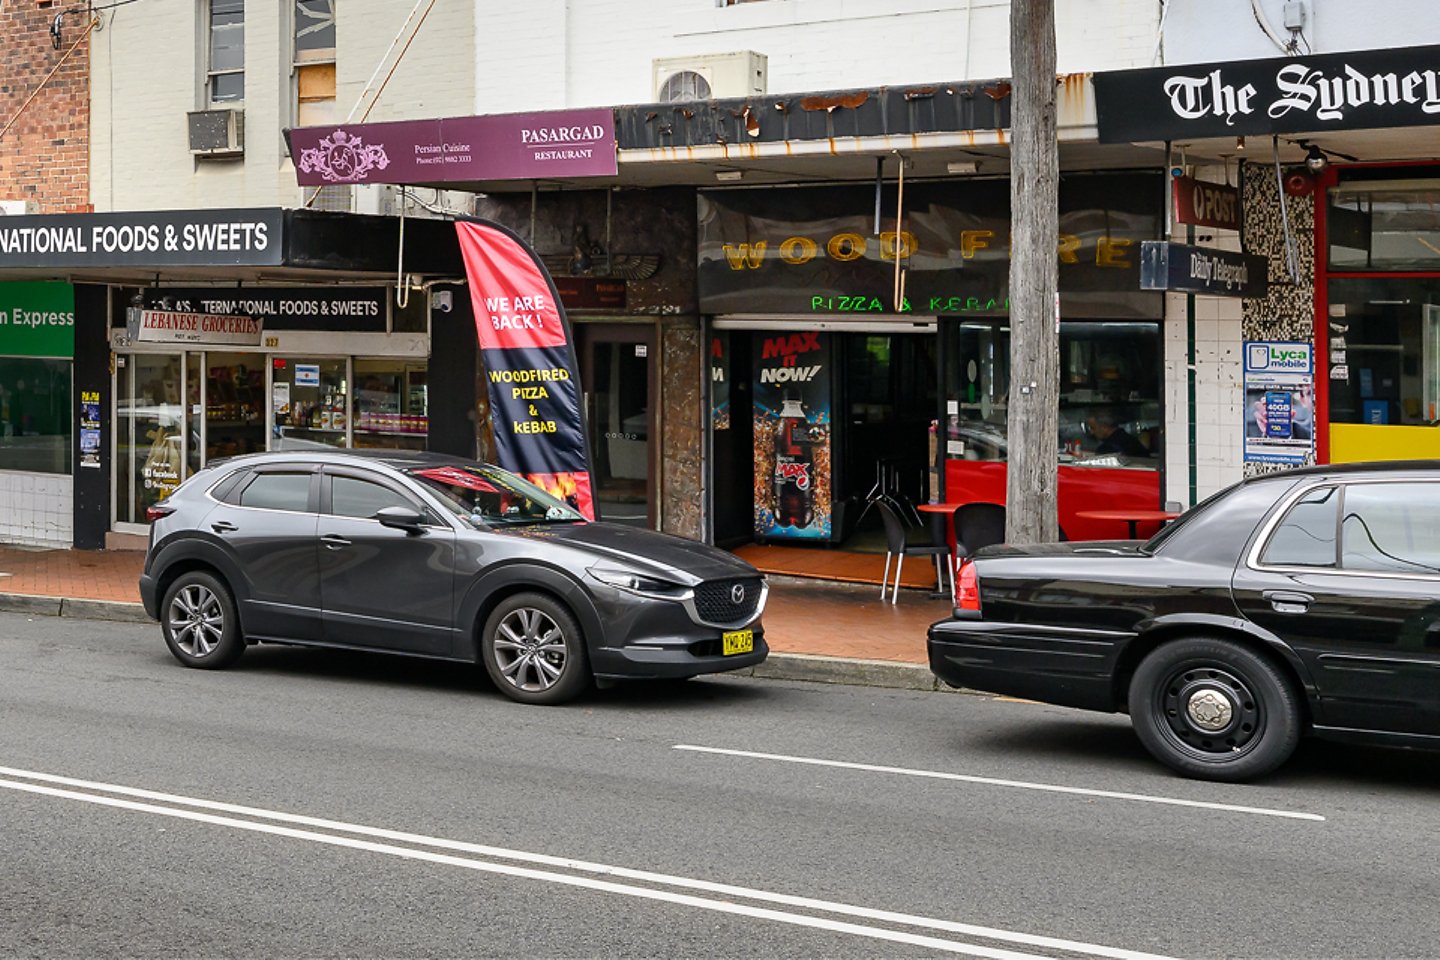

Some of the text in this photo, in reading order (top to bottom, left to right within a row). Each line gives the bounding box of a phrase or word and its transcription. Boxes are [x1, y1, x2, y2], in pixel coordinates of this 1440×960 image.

[1163, 68, 1257, 126] The
[522, 125, 604, 143] PASARGAD
[414, 143, 471, 154] Persian Cuisine
[534, 148, 593, 161] RESTAURANT
[1205, 189, 1236, 223] POST
[92, 225, 159, 253] FOODS
[164, 226, 178, 251] &
[182, 223, 268, 251] SWEETS
[722, 231, 918, 270] WOOD
[1190, 252, 1248, 290] Daily Telegraph
[279, 300, 319, 315] FOODS
[321, 300, 329, 315] &
[331, 300, 378, 316] SWEETS
[484, 295, 544, 311] WE ARE
[812, 296, 883, 312] PIZZA
[930, 298, 1010, 312] KEBA
[12, 309, 74, 328] Express
[144, 312, 258, 334] LEBANESE GROCERIES
[491, 314, 534, 329] BACK
[762, 331, 821, 358] MAX
[783, 354, 797, 367] IT
[1271, 347, 1307, 360] Lyca
[1271, 360, 1307, 368] mobile
[489, 368, 569, 383] WOODFIRED
[760, 365, 822, 383] NOW!
[512, 387, 549, 400] PIZZA
[529, 404, 538, 416] &
[775, 462, 810, 478] MAX
